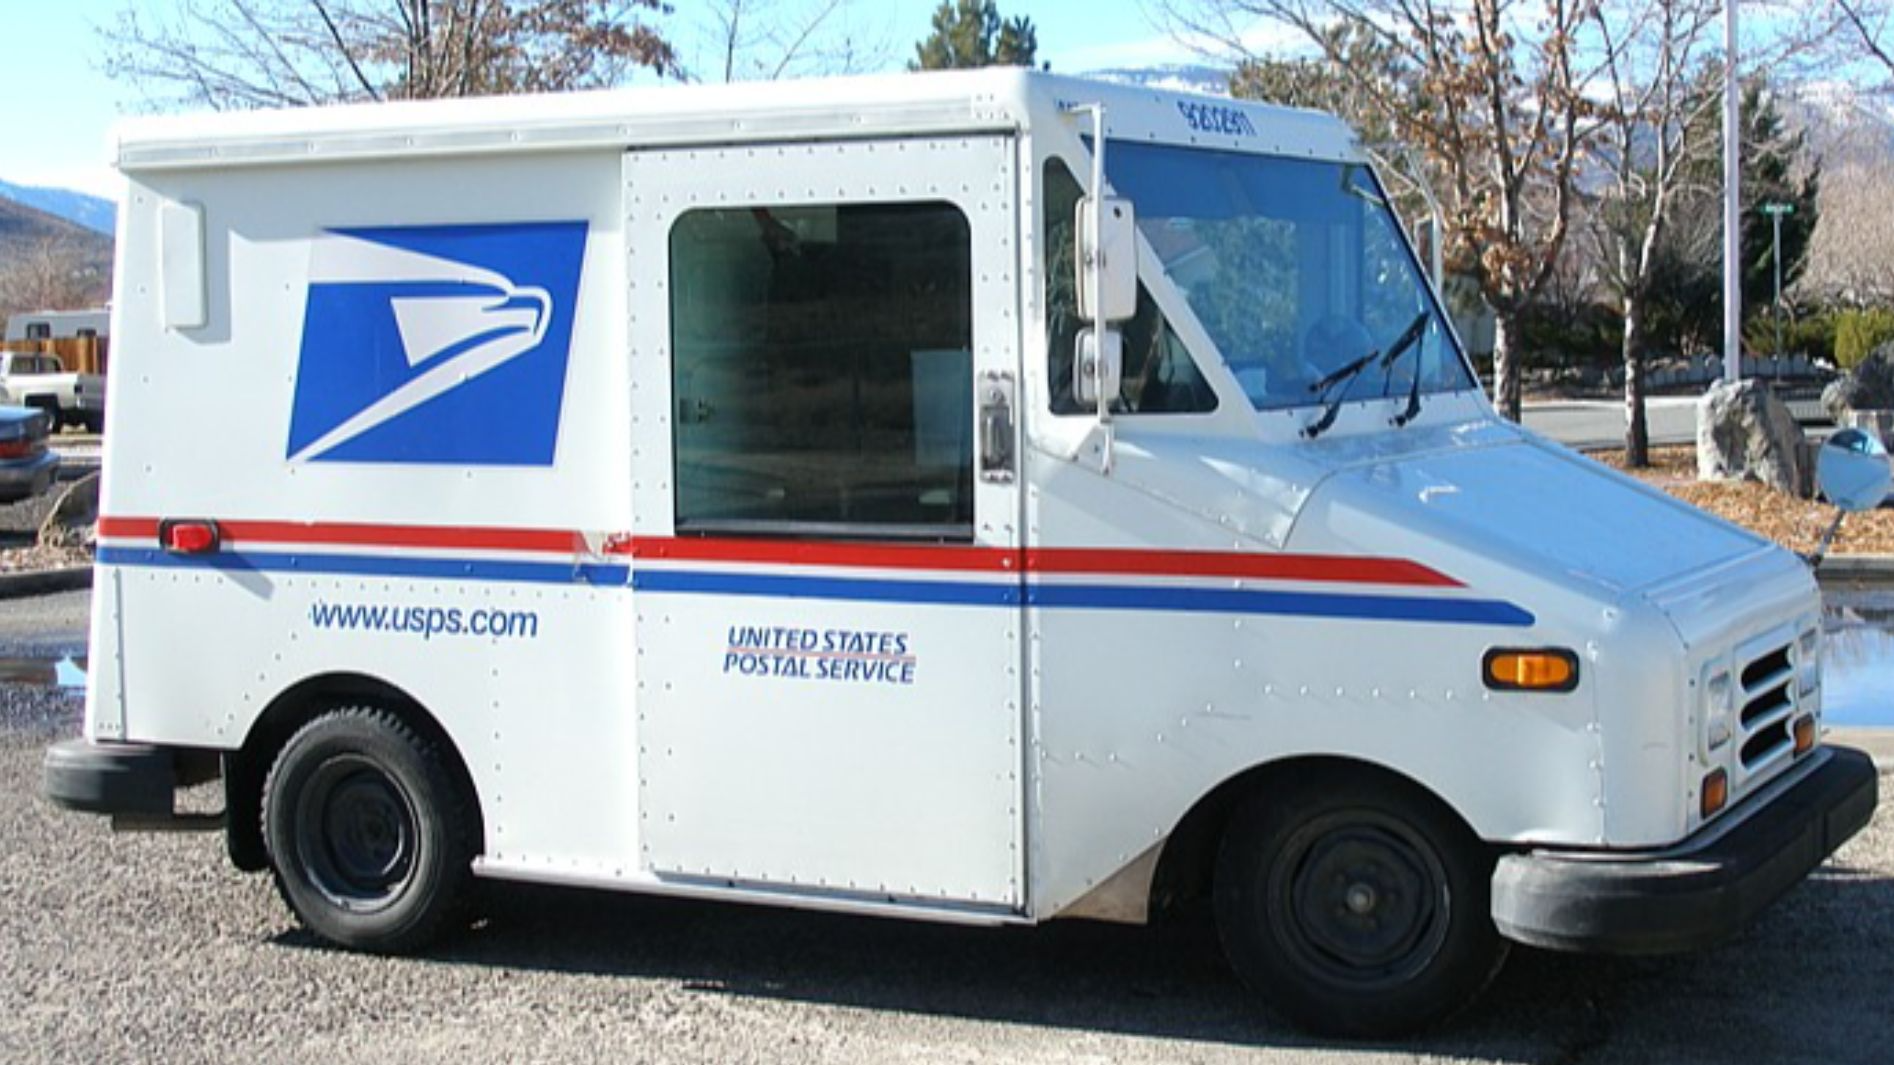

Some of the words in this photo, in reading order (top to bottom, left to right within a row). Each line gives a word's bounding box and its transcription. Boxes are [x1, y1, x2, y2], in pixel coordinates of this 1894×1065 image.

[312, 603, 538, 640] www.usps.com
[728, 626, 818, 650] UNITED
[822, 629, 909, 655] STATES
[723, 652, 811, 679] POSTAL
[815, 658, 916, 685] SERVICE
